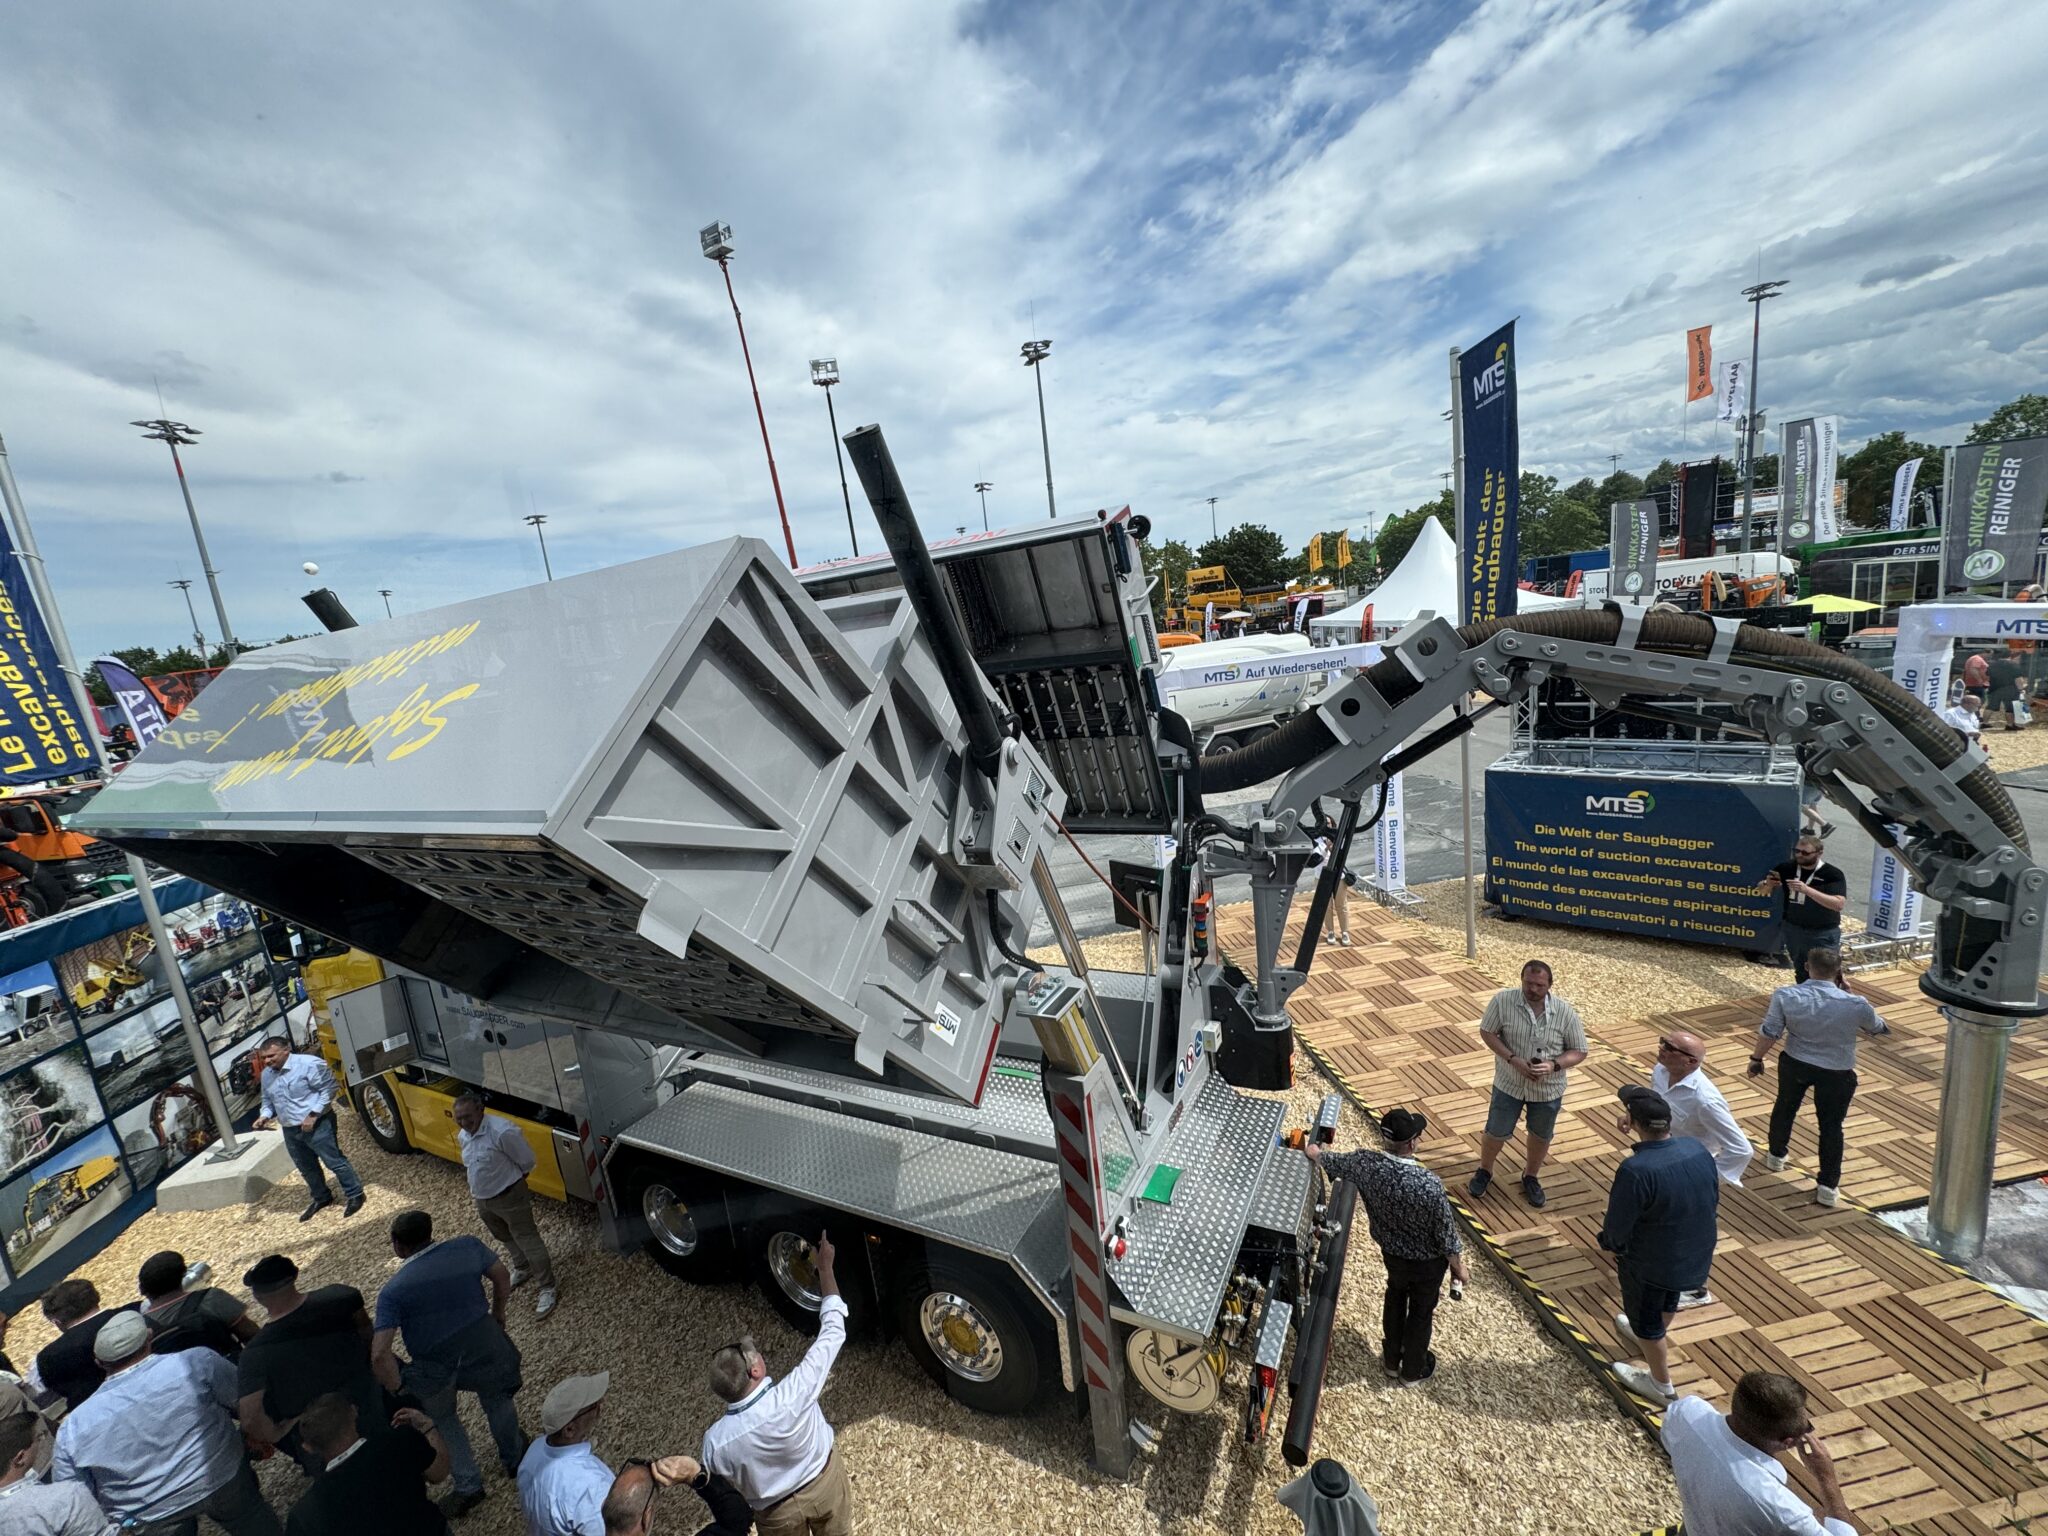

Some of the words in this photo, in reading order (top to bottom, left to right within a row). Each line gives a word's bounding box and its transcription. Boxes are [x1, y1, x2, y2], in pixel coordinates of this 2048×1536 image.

[1473, 359, 1506, 401] MTS
[1968, 445, 2002, 547] SINKKASTEN
[1989, 457, 2023, 535] REINIGER
[1472, 519, 1488, 583] Welt
[1481, 467, 1493, 512] der
[1628, 503, 1638, 569] SINKKASTEN
[1893, 547, 1916, 556] DER
[1204, 670, 1236, 684] MTS
[1246, 667, 1266, 679] Auf
[1269, 656, 1348, 676] Wiedersehen!
[1585, 795, 1645, 814] MTS
[1388, 819, 1400, 880] Bienvenido
[1514, 841, 1537, 852] The
[1540, 845, 1577, 857] world
[1580, 848, 1595, 858] of
[1598, 850, 1650, 864] suction
[1655, 856, 1741, 874] excavators
[1535, 824, 1556, 835] Die
[1559, 826, 1592, 839] Welt
[1595, 829, 1619, 841] der
[1622, 832, 1715, 850] Saugbagger
[1492, 857, 1503, 867] El
[1505, 859, 1547, 873] mundo
[1550, 864, 1566, 875] de
[1569, 866, 1589, 877] las
[1592, 869, 1683, 888] excavadoras
[1686, 880, 1705, 891] se
[1874, 856, 1897, 930] Bienvenue
[1492, 875, 1506, 885] Le
[1508, 878, 1550, 891] monde
[1552, 883, 1576, 895] des
[1579, 887, 1669, 906] excavatrices
[1673, 898, 1771, 919] aspiratrices
[1502, 894, 1509, 903] Il
[1512, 896, 1552, 910] mondo
[1555, 902, 1587, 916] degli
[1590, 907, 1665, 926] escavatori
[1669, 918, 1679, 927] a
[1683, 919, 1756, 938] risucchio
[938, 1013, 958, 1035] MTS
